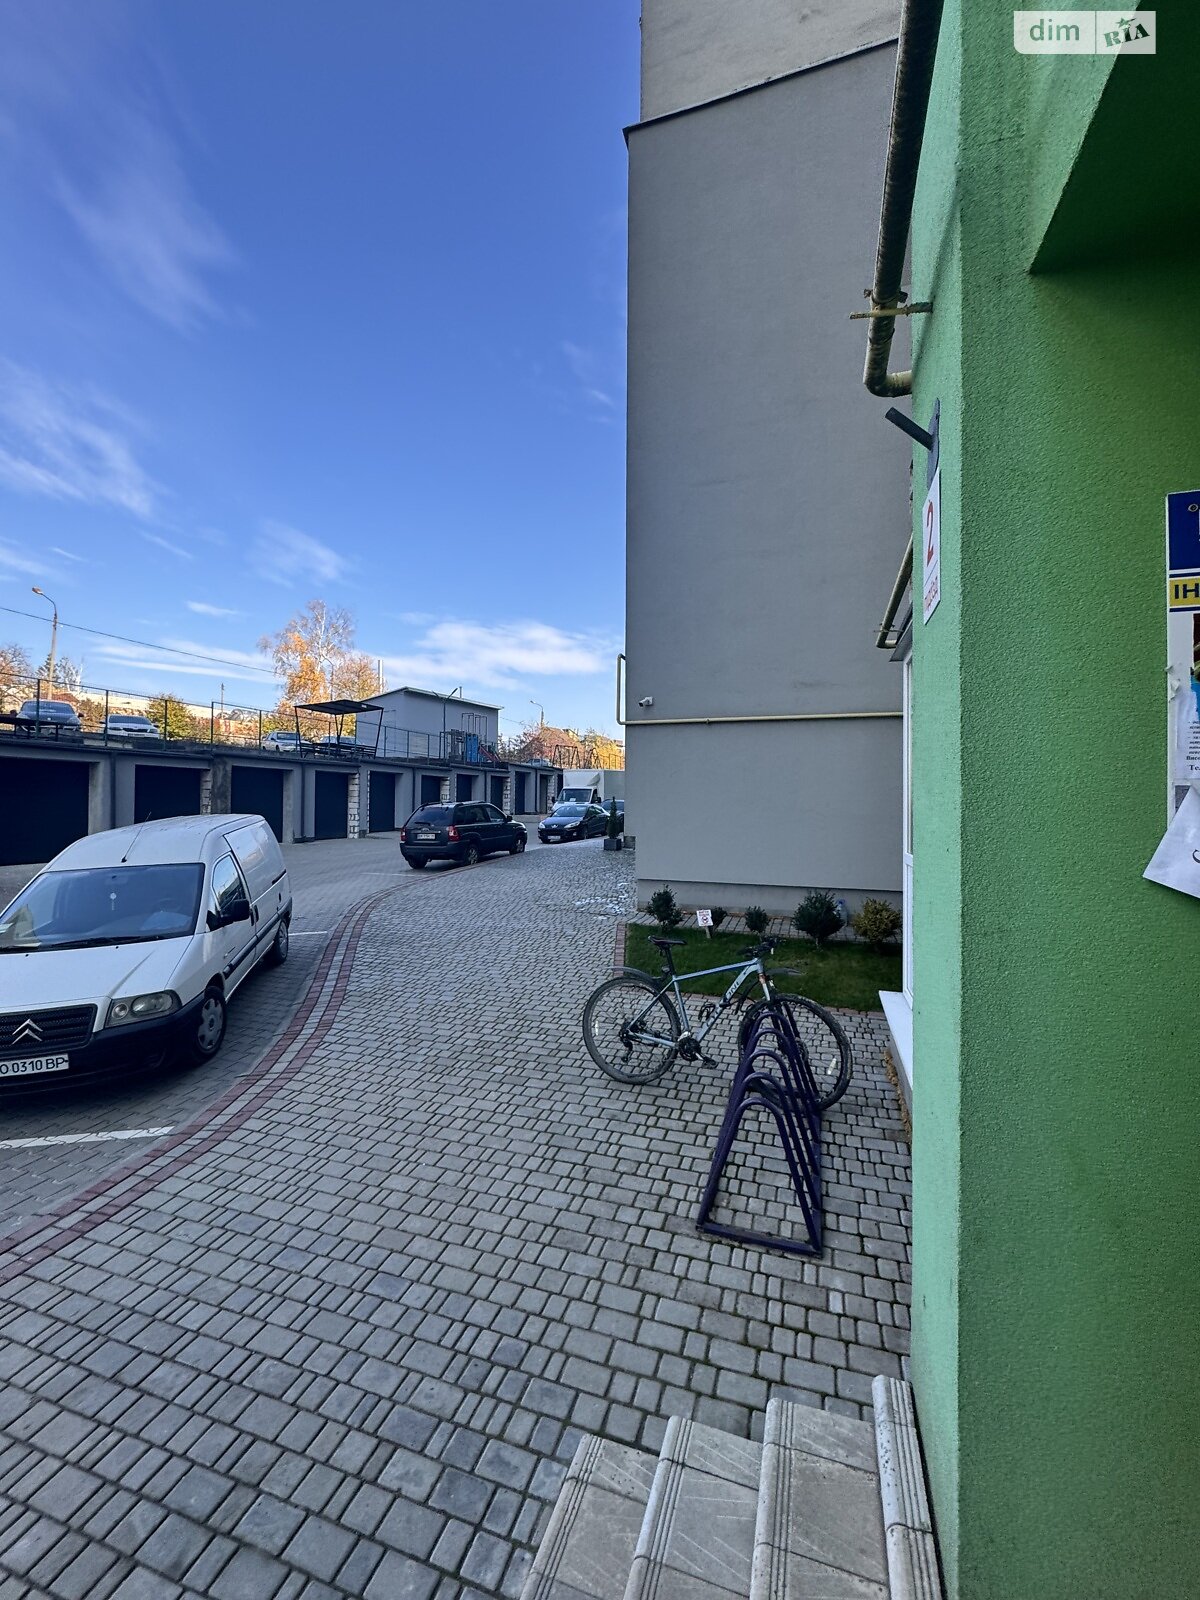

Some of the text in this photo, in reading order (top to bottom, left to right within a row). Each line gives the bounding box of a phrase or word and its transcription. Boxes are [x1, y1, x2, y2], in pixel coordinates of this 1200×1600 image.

[926, 500, 934, 567] 2
[12, 1060, 43, 1073] 0310
[45, 1056, 65, 1069] BP
